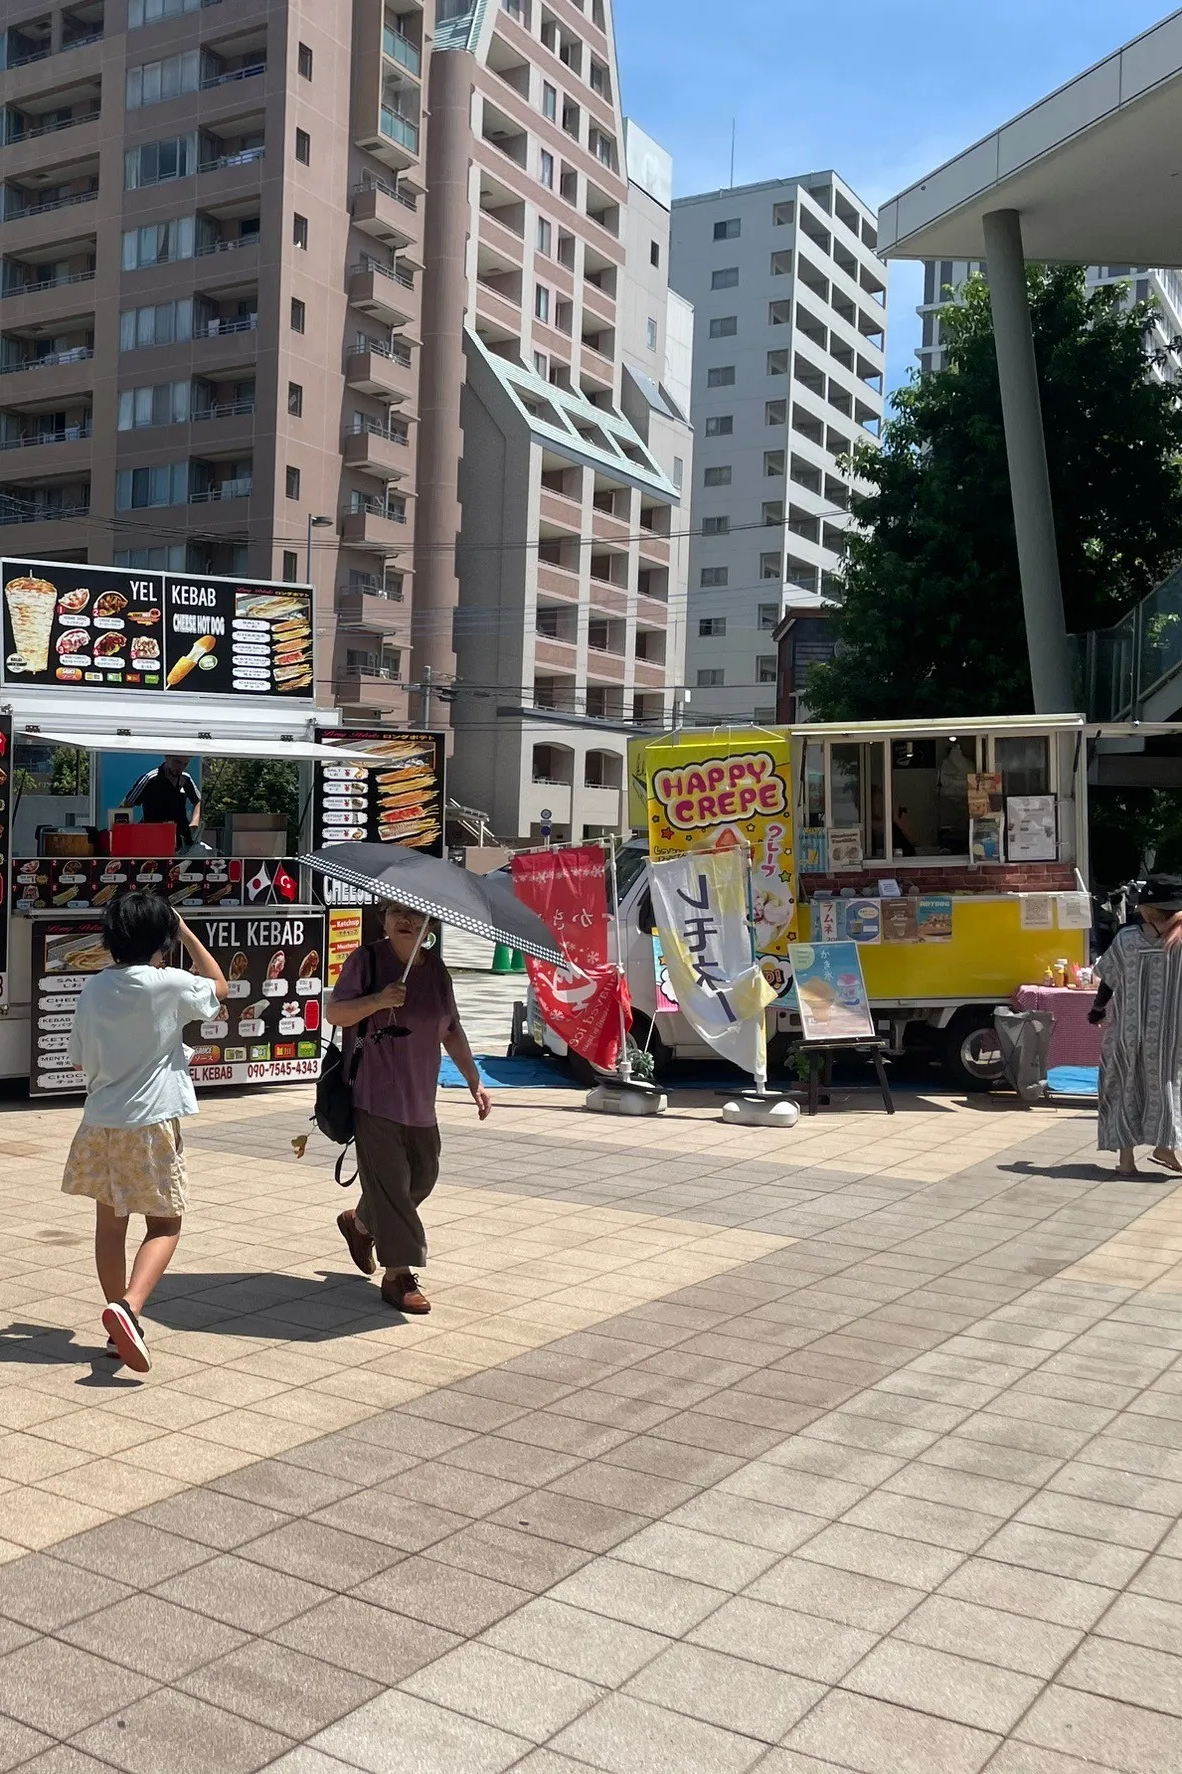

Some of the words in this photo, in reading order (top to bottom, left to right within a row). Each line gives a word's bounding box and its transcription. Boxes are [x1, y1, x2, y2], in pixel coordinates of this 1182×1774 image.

[129, 580, 158, 602] YEL
[171, 584, 217, 607] KEBAB
[173, 613, 198, 634] CHEESE
[198, 615, 211, 635] HOT
[211, 616, 225, 636] DOG
[662, 760, 767, 799] HAPPY
[675, 783, 778, 823] CREPE
[761, 824, 783, 878] クレープ
[336, 918, 360, 928] Ketchup
[823, 902, 834, 935] ラムネ
[205, 922, 241, 948] YEL
[247, 921, 305, 947] KEBAB
[820, 949, 834, 981] かき氷
[189, 1068, 200, 1082] EL
[202, 1065, 233, 1080] KEBAB
[247, 1060, 318, 1078] 090-7545-4343
